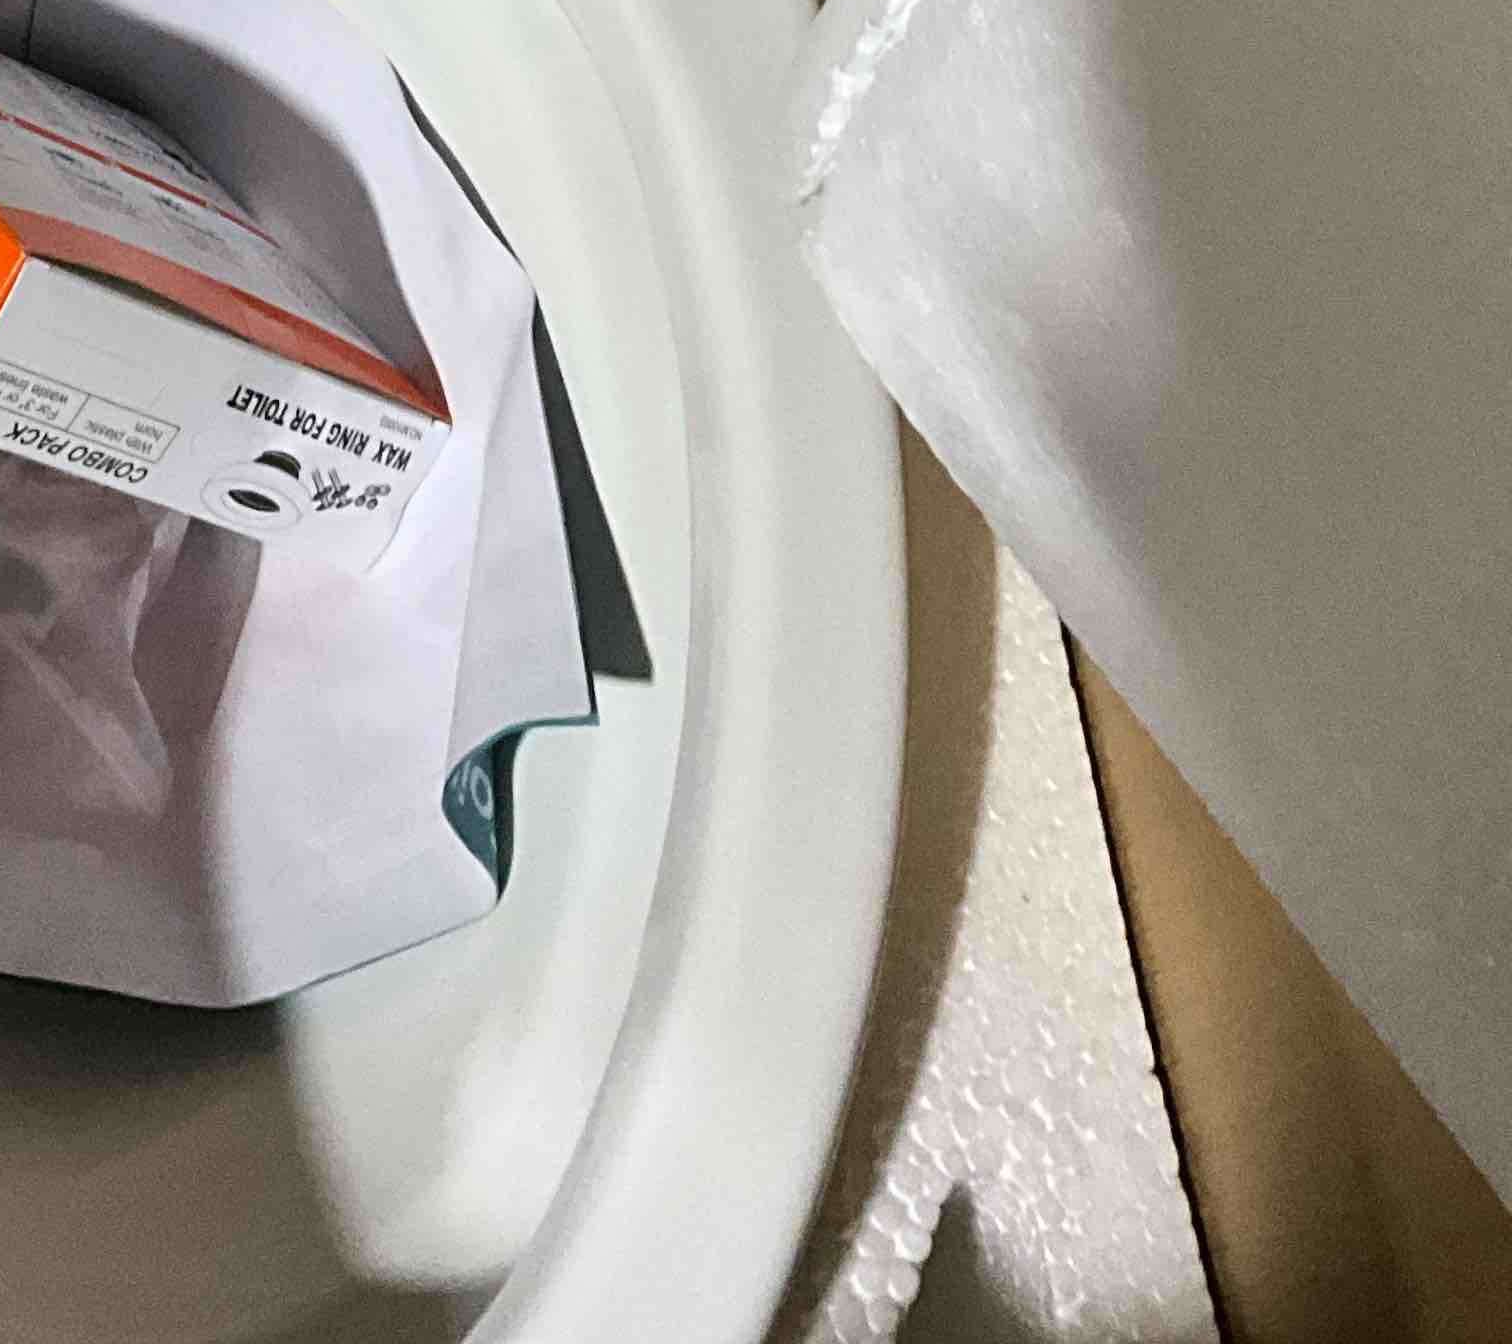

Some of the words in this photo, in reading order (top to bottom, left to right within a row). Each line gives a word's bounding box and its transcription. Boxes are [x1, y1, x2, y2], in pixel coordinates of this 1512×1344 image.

[226, 385, 288, 426] TOILET
[4, 422, 70, 455] PACK
[290, 407, 327, 440] FOR
[326, 423, 370, 456] RING
[68, 445, 148, 483] COMBO
[371, 441, 412, 471] WAX
